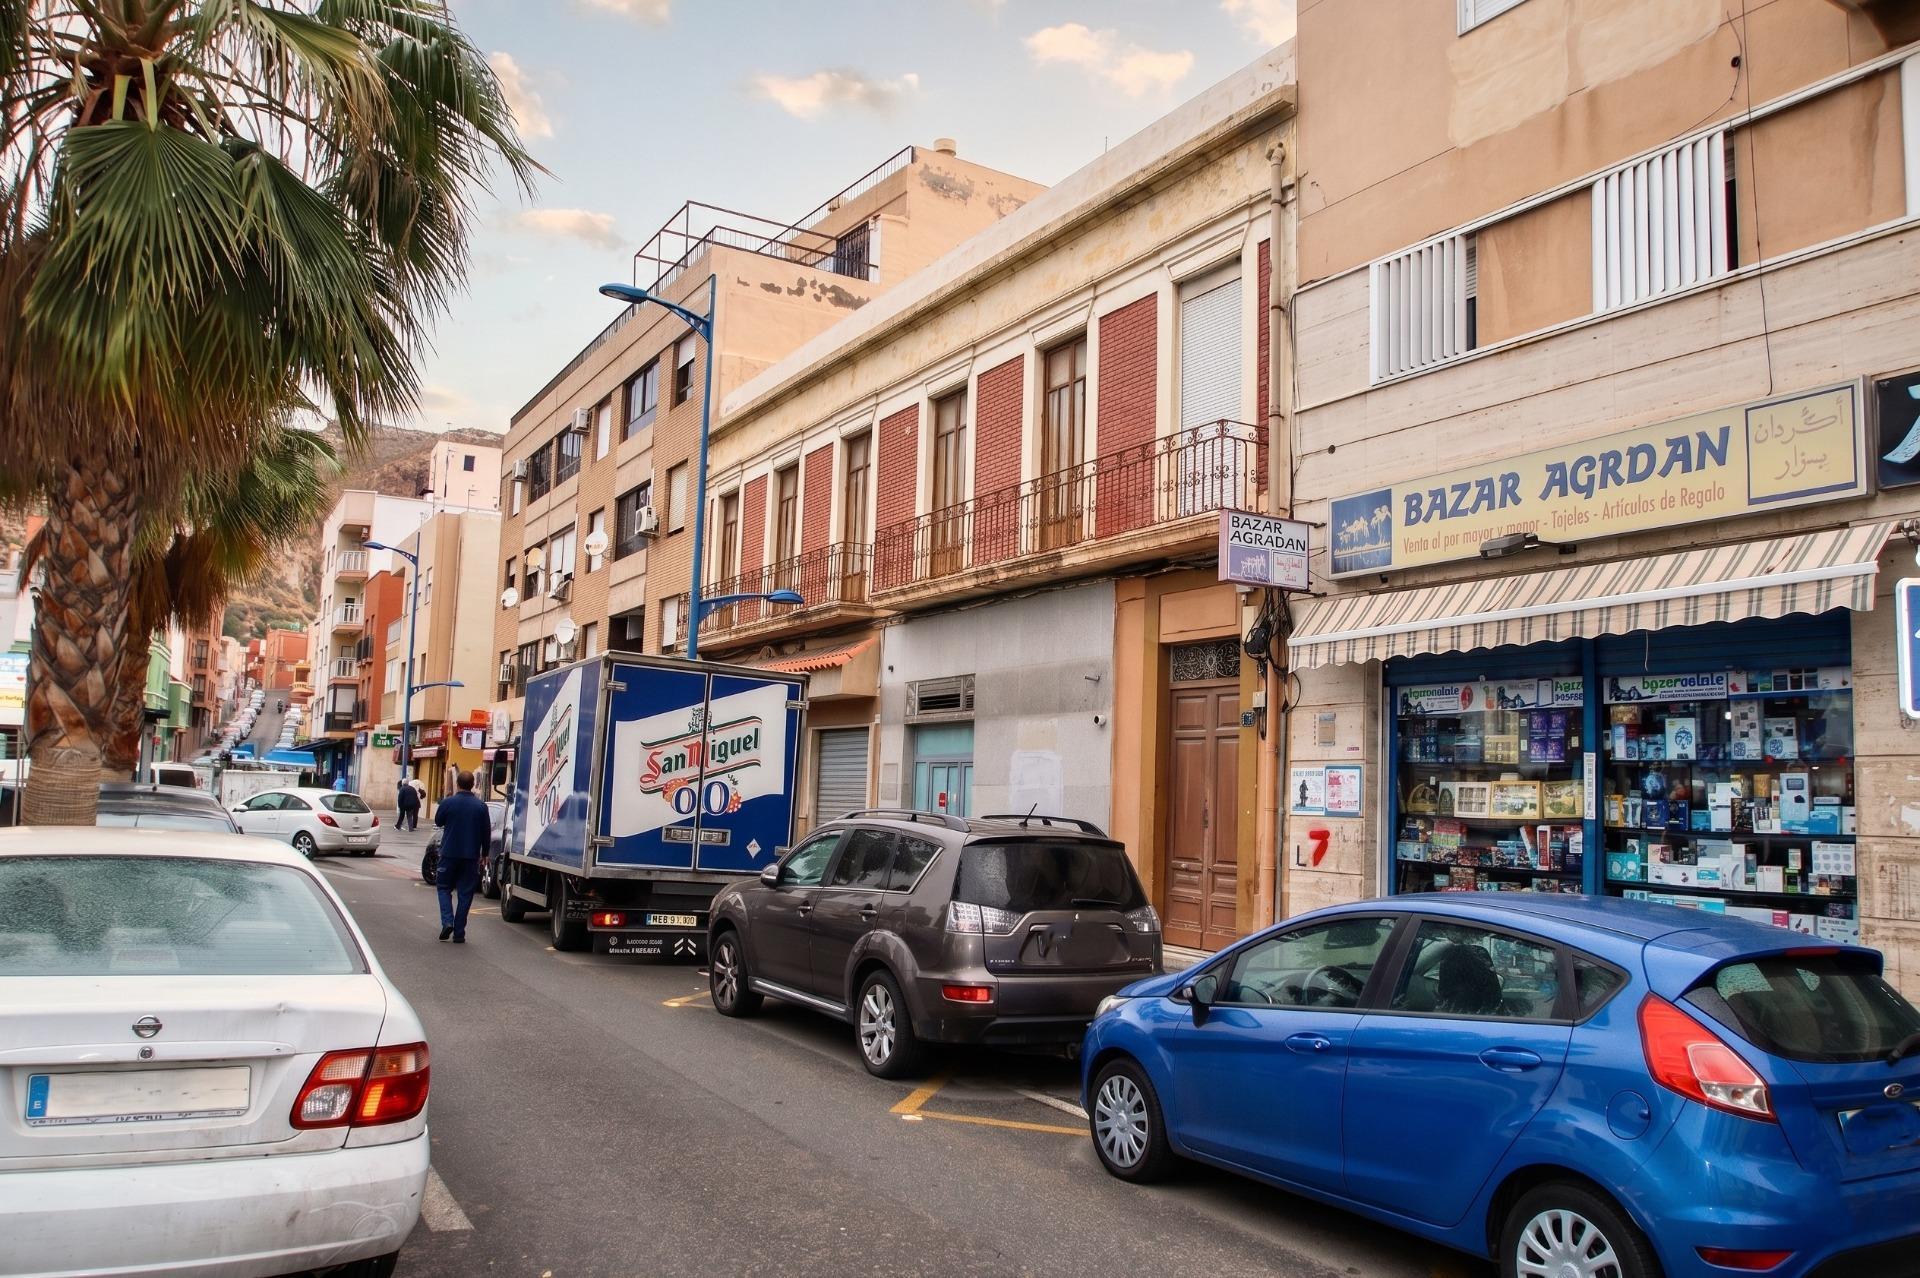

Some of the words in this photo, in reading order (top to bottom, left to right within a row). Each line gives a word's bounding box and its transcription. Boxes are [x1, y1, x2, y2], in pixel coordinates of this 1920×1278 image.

[1403, 471, 1522, 527] BAZAR
[1537, 425, 1731, 501] AGRDAN
[1231, 515, 1283, 535] BAZAR
[1403, 537, 1429, 554] Venta
[1432, 531, 1441, 550] al
[1444, 533, 1460, 549] por
[1462, 527, 1494, 546] mayor
[1602, 493, 1655, 520] Artículos
[1660, 489, 1676, 510] de
[1680, 480, 1725, 509] Regalo
[1230, 530, 1306, 552] AGRADAN
[640, 751, 686, 784] San
[683, 727, 760, 769] Miguel
[1309, 829, 1331, 867] 7
[33, 1101, 42, 1110] E
